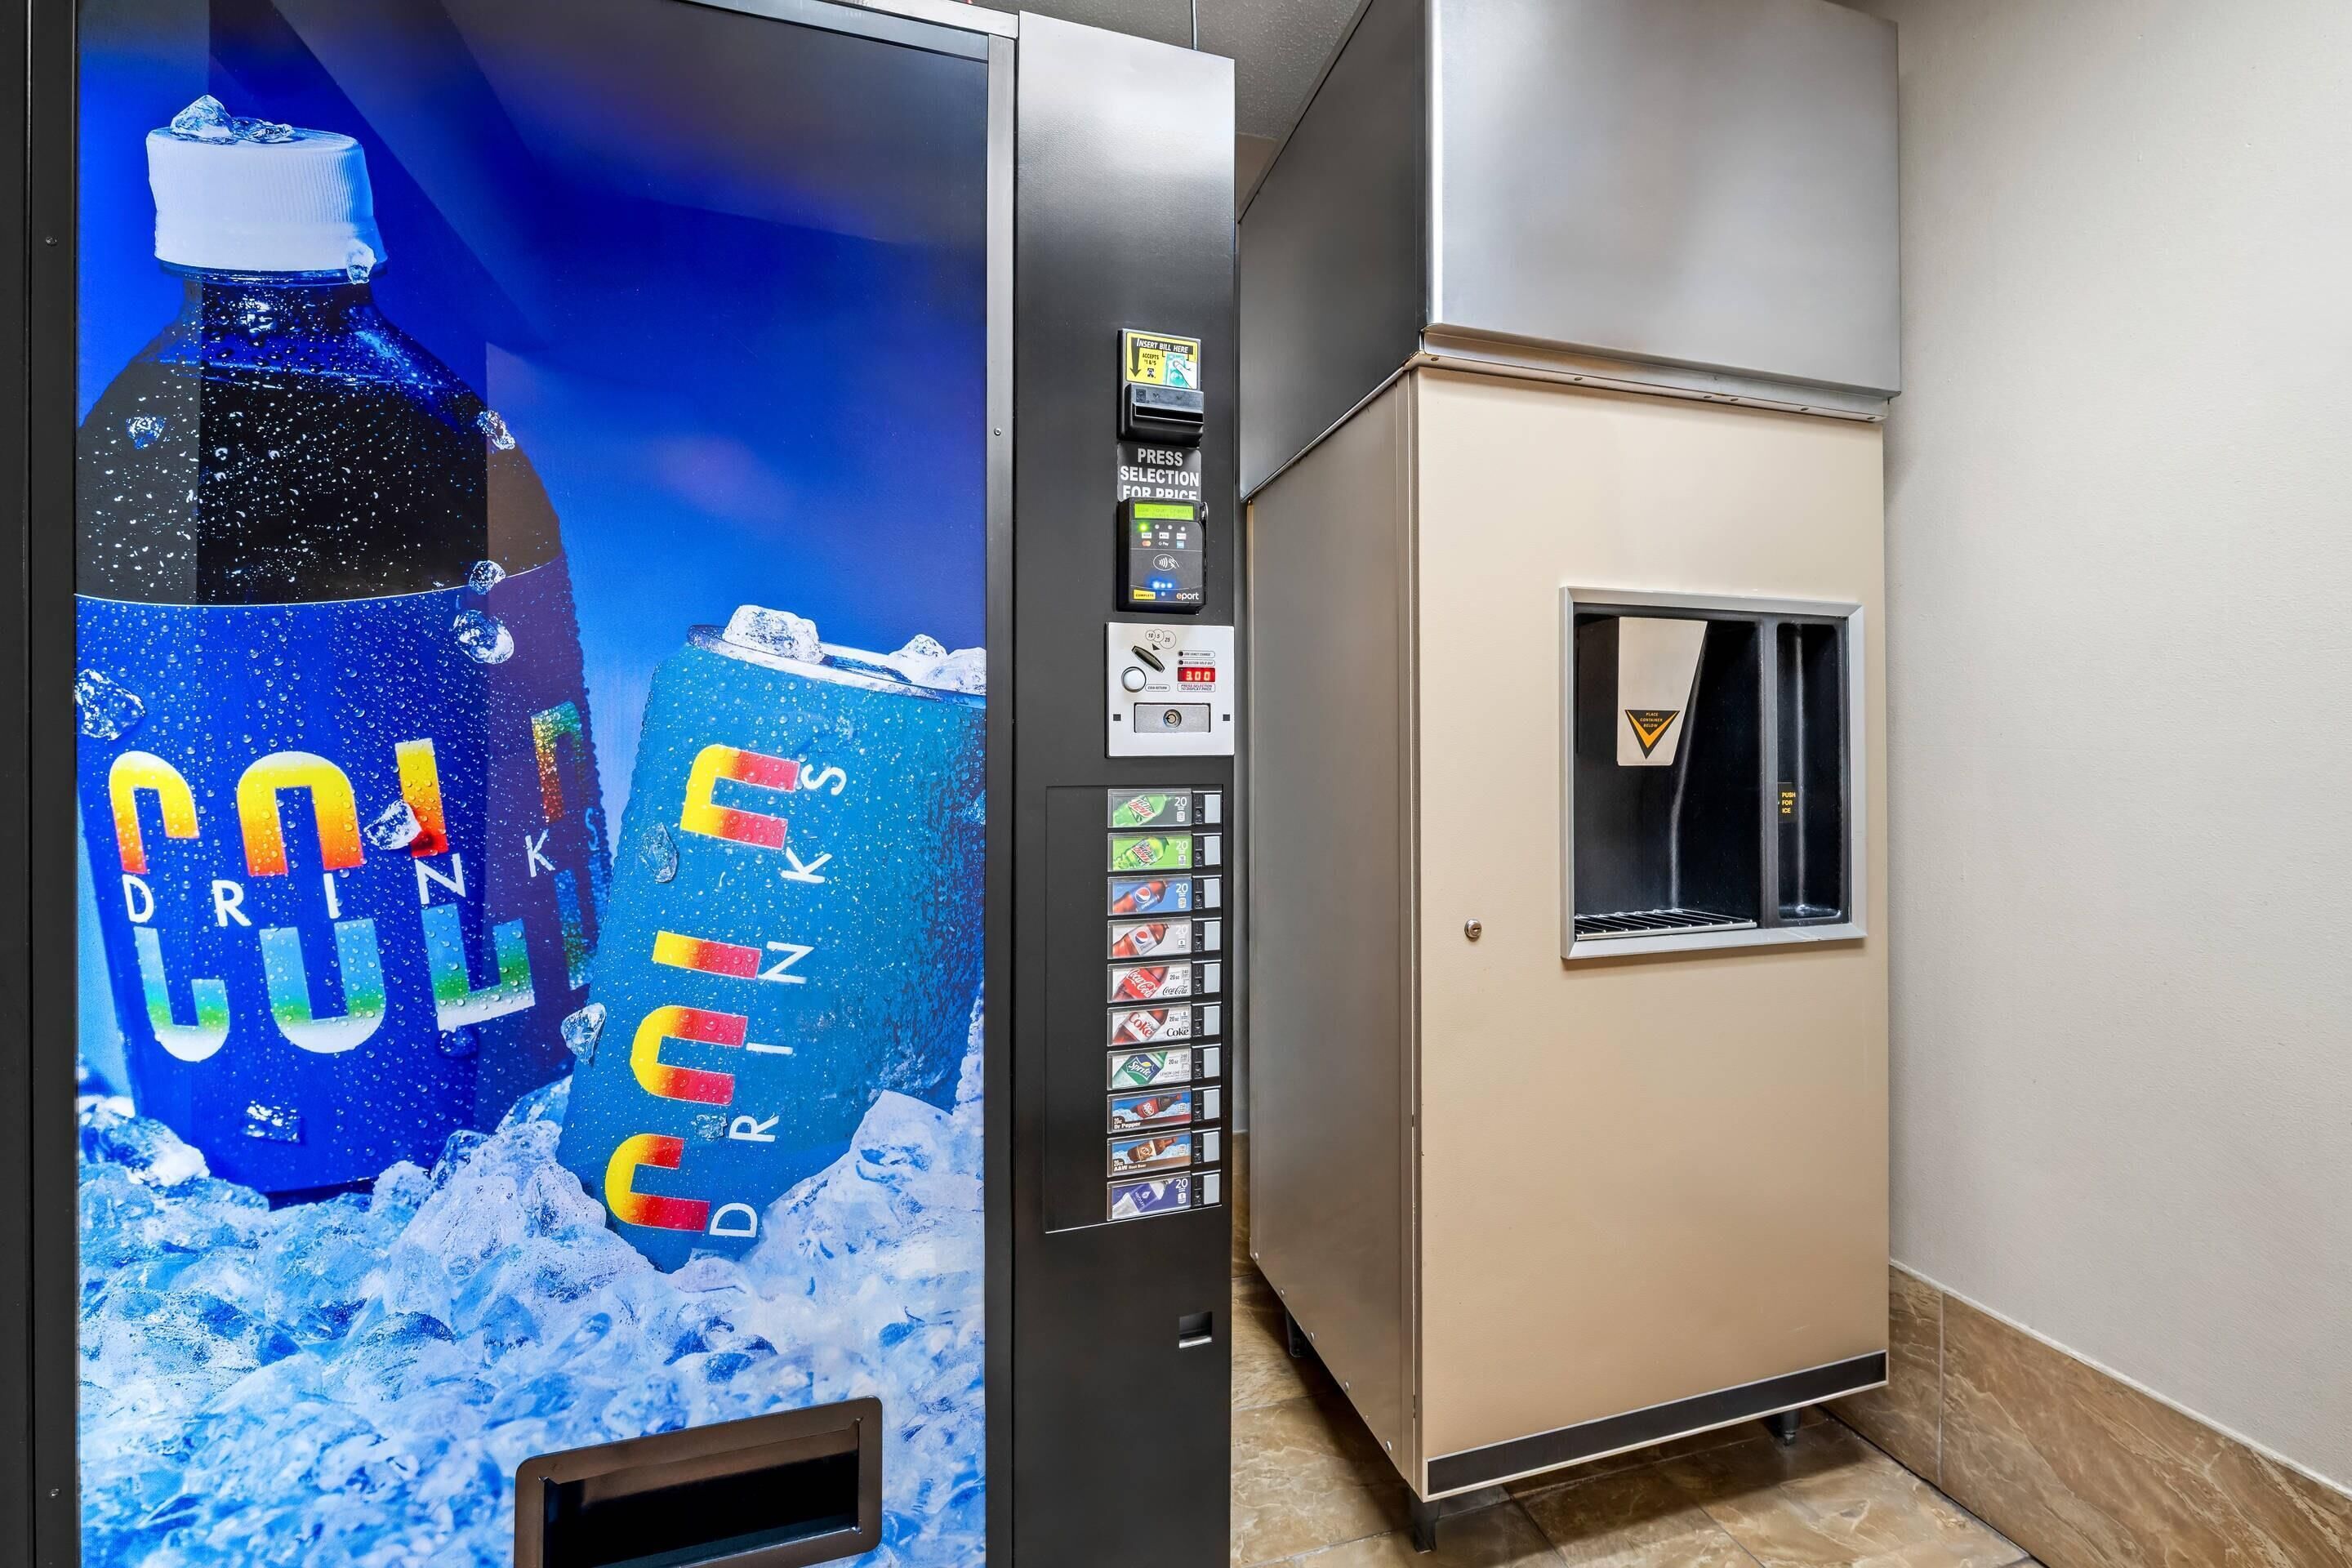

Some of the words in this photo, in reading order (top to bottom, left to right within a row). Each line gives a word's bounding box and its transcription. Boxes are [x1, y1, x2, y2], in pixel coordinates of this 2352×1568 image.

[1136, 337, 1158, 350] INSERT
[1160, 341, 1173, 352] BILL
[1173, 344, 1189, 354] HERE
[1138, 448, 1183, 466] PRESS
[1120, 466, 1200, 487] SELECTION
[1123, 485, 1154, 499] FOR
[1156, 487, 1197, 500] PRICE
[1176, 592, 1199, 601] eport
[1174, 797, 1187, 806] 20
[1176, 841, 1188, 850] 20
[122, 807, 599, 927] DRINKS
[1176, 883, 1188, 893] 20
[1176, 925, 1188, 935] 20
[709, 763, 847, 1238] DRINKS
[1129, 1012, 1153, 1037] Coke
[1166, 1028, 1189, 1037] Coke
[1128, 1061, 1152, 1077] Sprite
[1175, 1178, 1188, 1188] 20
